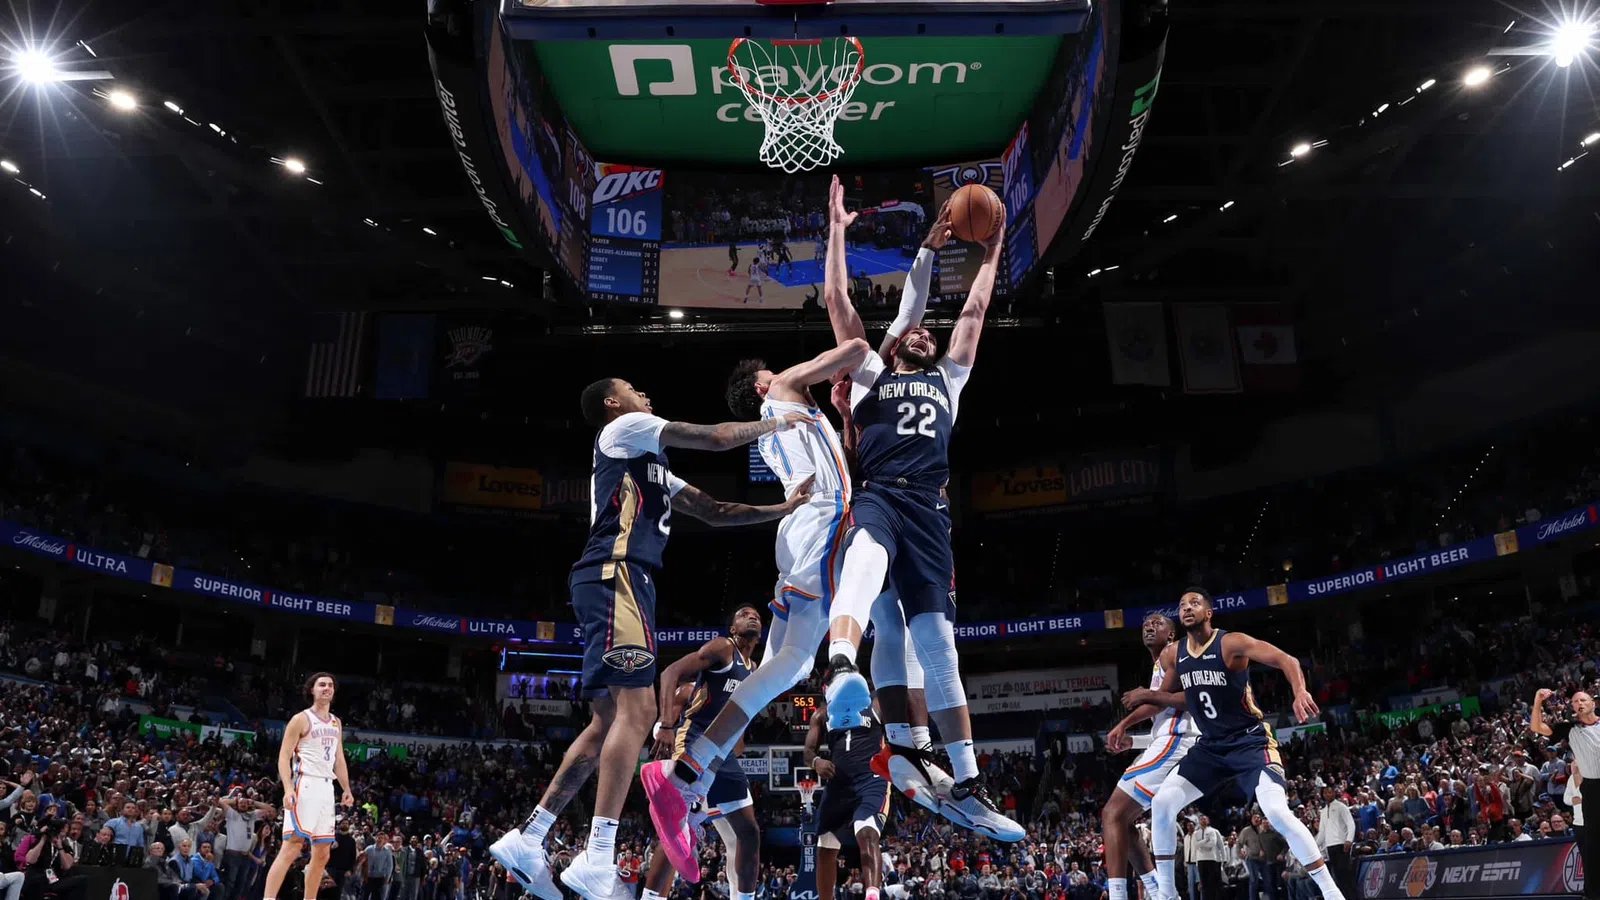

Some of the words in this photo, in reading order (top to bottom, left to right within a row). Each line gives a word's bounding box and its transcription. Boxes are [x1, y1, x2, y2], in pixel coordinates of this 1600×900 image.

[1109, 110, 1149, 191] paycom
[592, 169, 662, 205] OKC
[1010, 173, 1028, 218] 106
[569, 177, 586, 221] 108
[606, 207, 647, 236] 106
[878, 382, 906, 401] NEW
[896, 401, 937, 438] 22
[647, 462, 664, 486] NEW
[1069, 461, 1116, 497] LOUD
[1120, 459, 1160, 485] CITY
[1536, 511, 1586, 540] Michelob
[12, 531, 65, 555] Michelob
[76, 548, 128, 573] ULTRA
[1307, 570, 1375, 595] SUPERIOR
[1384, 557, 1427, 578] LIGHT
[1431, 547, 1469, 567] BEER
[193, 577, 262, 602] SUPERIOR
[271, 594, 313, 612] LIGHT
[316, 601, 351, 616] BEER
[412, 614, 458, 630] Michelob
[469, 621, 516, 635] ULTRA
[654, 631, 684, 641] IGHT
[687, 631, 720, 641] BEER
[953, 624, 997, 637] PERIOR
[1007, 620, 1045, 634] LIGHT
[1048, 617, 1082, 630] BEER
[981, 683, 1001, 695] POST
[1014, 680, 1031, 693] OAK
[1032, 678, 1063, 690] PARTY
[1065, 675, 1107, 689] TERRACE
[1191, 669, 1227, 687] ORLEANS
[793, 696, 815, 707] 56.9
[1199, 691, 1218, 719] 3
[321, 736, 334, 746] CITY
[844, 729, 852, 752] 1
[1070, 740, 1089, 751] 112
[324, 746, 331, 762] 3
[741, 759, 768, 767] HEALTH
[804, 846, 814, 855] GET
[804, 855, 814, 864] THE
[804, 864, 815, 872] APP
[1441, 866, 1480, 884] NEXT
[1481, 860, 1522, 882] ESPN
